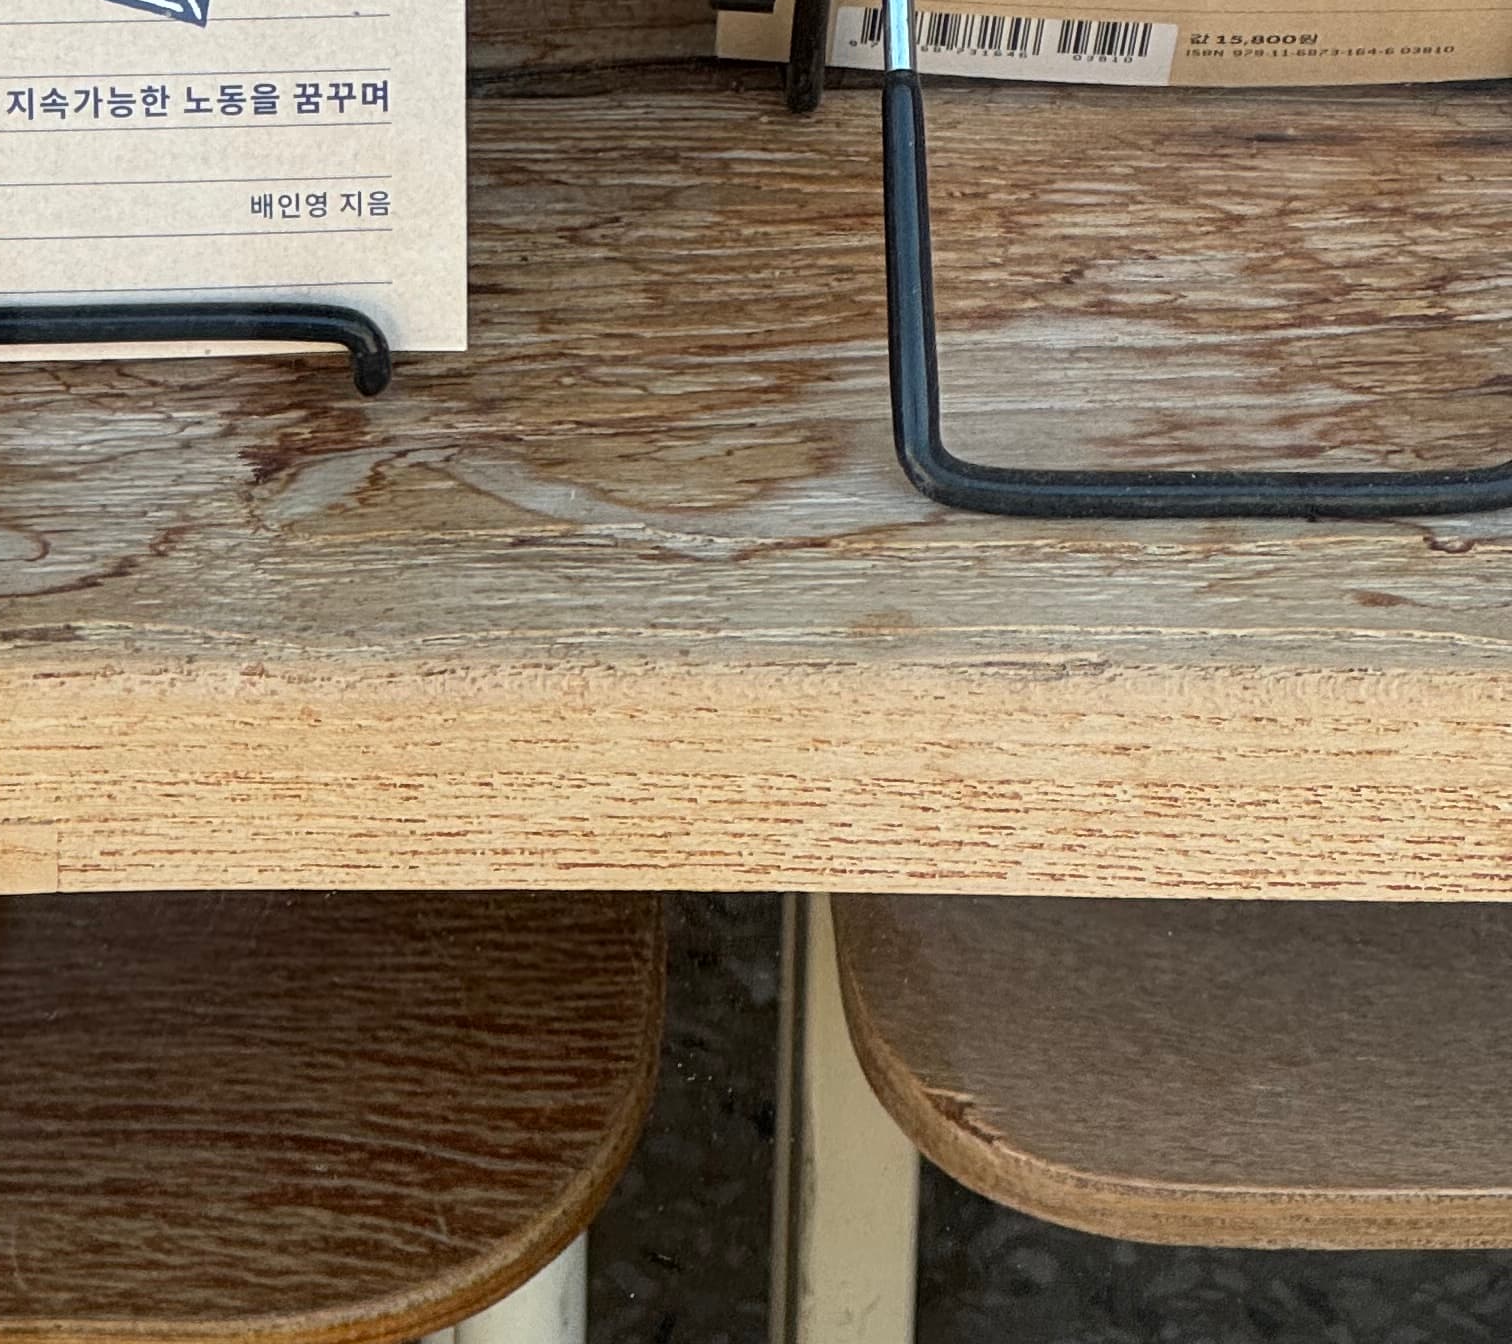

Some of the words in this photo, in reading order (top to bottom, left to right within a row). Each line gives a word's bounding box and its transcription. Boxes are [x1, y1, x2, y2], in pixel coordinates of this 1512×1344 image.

[1216, 33, 1318, 46] 15,800원
[6, 85, 170, 121] 지속가능한
[183, 82, 280, 116] 노동을
[293, 80, 389, 114] 꿈꾸며
[250, 191, 328, 220] 배인영
[340, 191, 390, 217] 지음
